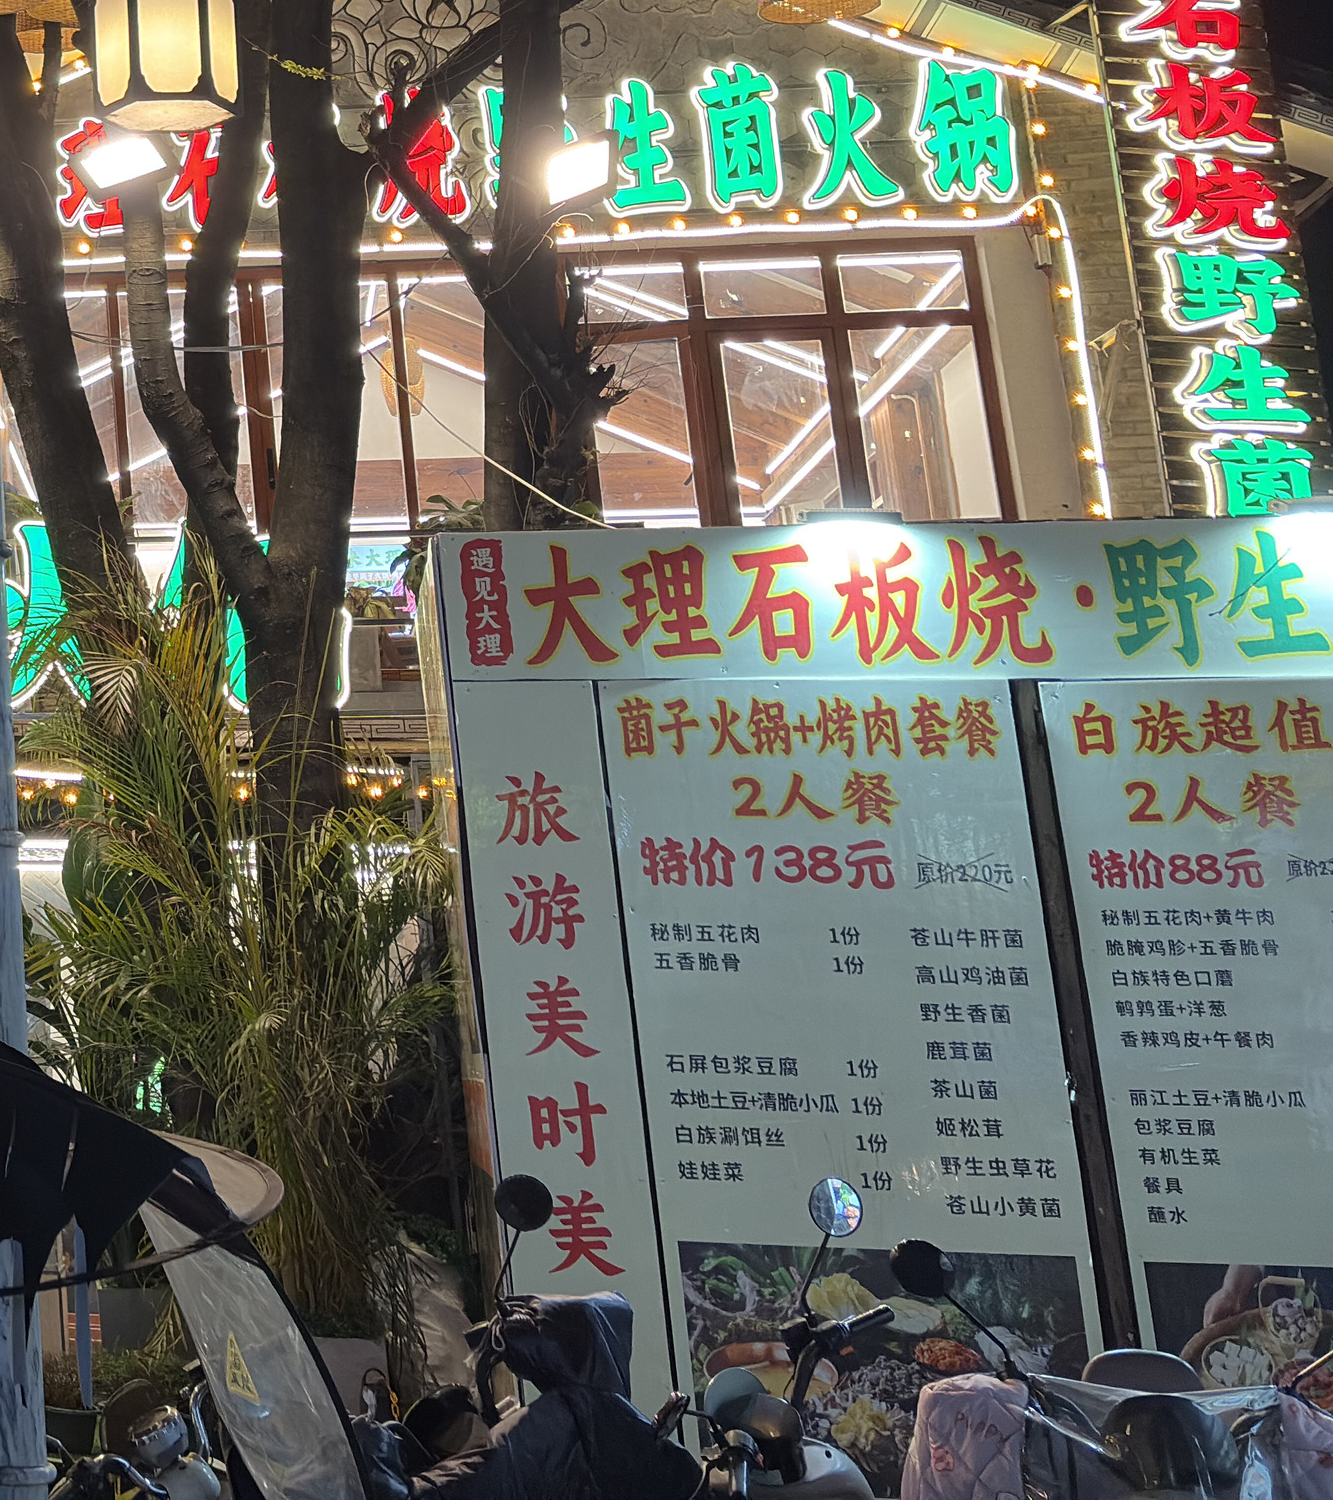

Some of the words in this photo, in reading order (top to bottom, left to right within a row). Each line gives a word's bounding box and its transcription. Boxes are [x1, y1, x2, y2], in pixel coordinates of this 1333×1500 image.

[469, 547, 504, 658] 遇见大理
[617, 695, 1001, 758] 菌子火锅+烤肉套餐
[1072, 697, 1333, 756] 白族超值
[732, 770, 899, 827] 2人餐
[1124, 771, 1301, 828] 2人餐
[639, 836, 896, 891] 特价138元
[1088, 848, 1265, 890] 特价88元
[1101, 908, 1275, 927] 秘制五花肉+黄牛肉
[649, 922, 760, 945] 秘制五花肉
[829, 927, 861, 946] 1份
[910, 927, 1025, 949] 苍山牛肝菌
[1106, 939, 1279, 957] 脆腌鸡胗+五香脆骨
[654, 952, 741, 973] 五香脆骨
[833, 955, 865, 975] 1份
[915, 965, 1030, 987] 高山鸡油菌
[1111, 969, 1234, 988] 白族特色口蘑
[495, 770, 626, 1276] 旅游美时美
[920, 1003, 1012, 1025] 野生香菌
[1120, 1030, 1275, 1049] 香辣鸡皮+午餐肉
[925, 1041, 994, 1063] 鹿茸菌
[665, 1054, 800, 1077] 石屏包浆豆腐
[846, 1059, 879, 1079] 1份
[930, 1079, 999, 1101] 茶山菌
[1129, 1089, 1307, 1109] 丽江土豆+清脆小瓜
[669, 1089, 840, 1115] 本地土豆+清脆小瓜
[851, 1096, 884, 1117] 1份
[675, 1124, 786, 1148] 白族涮饵丝
[936, 1117, 1005, 1139] 姬松茸
[1133, 1118, 1217, 1137] 包浆豆腐
[856, 1133, 888, 1154] 1份
[940, 1156, 1058, 1180] 野生虫草花
[1138, 1148, 1222, 1167] 有机生菜
[678, 1160, 745, 1182] 娃娃菜
[861, 1171, 893, 1192] 1份
[1143, 1176, 1183, 1194] 餐具
[946, 1195, 1063, 1220] 苍山小黄菌
